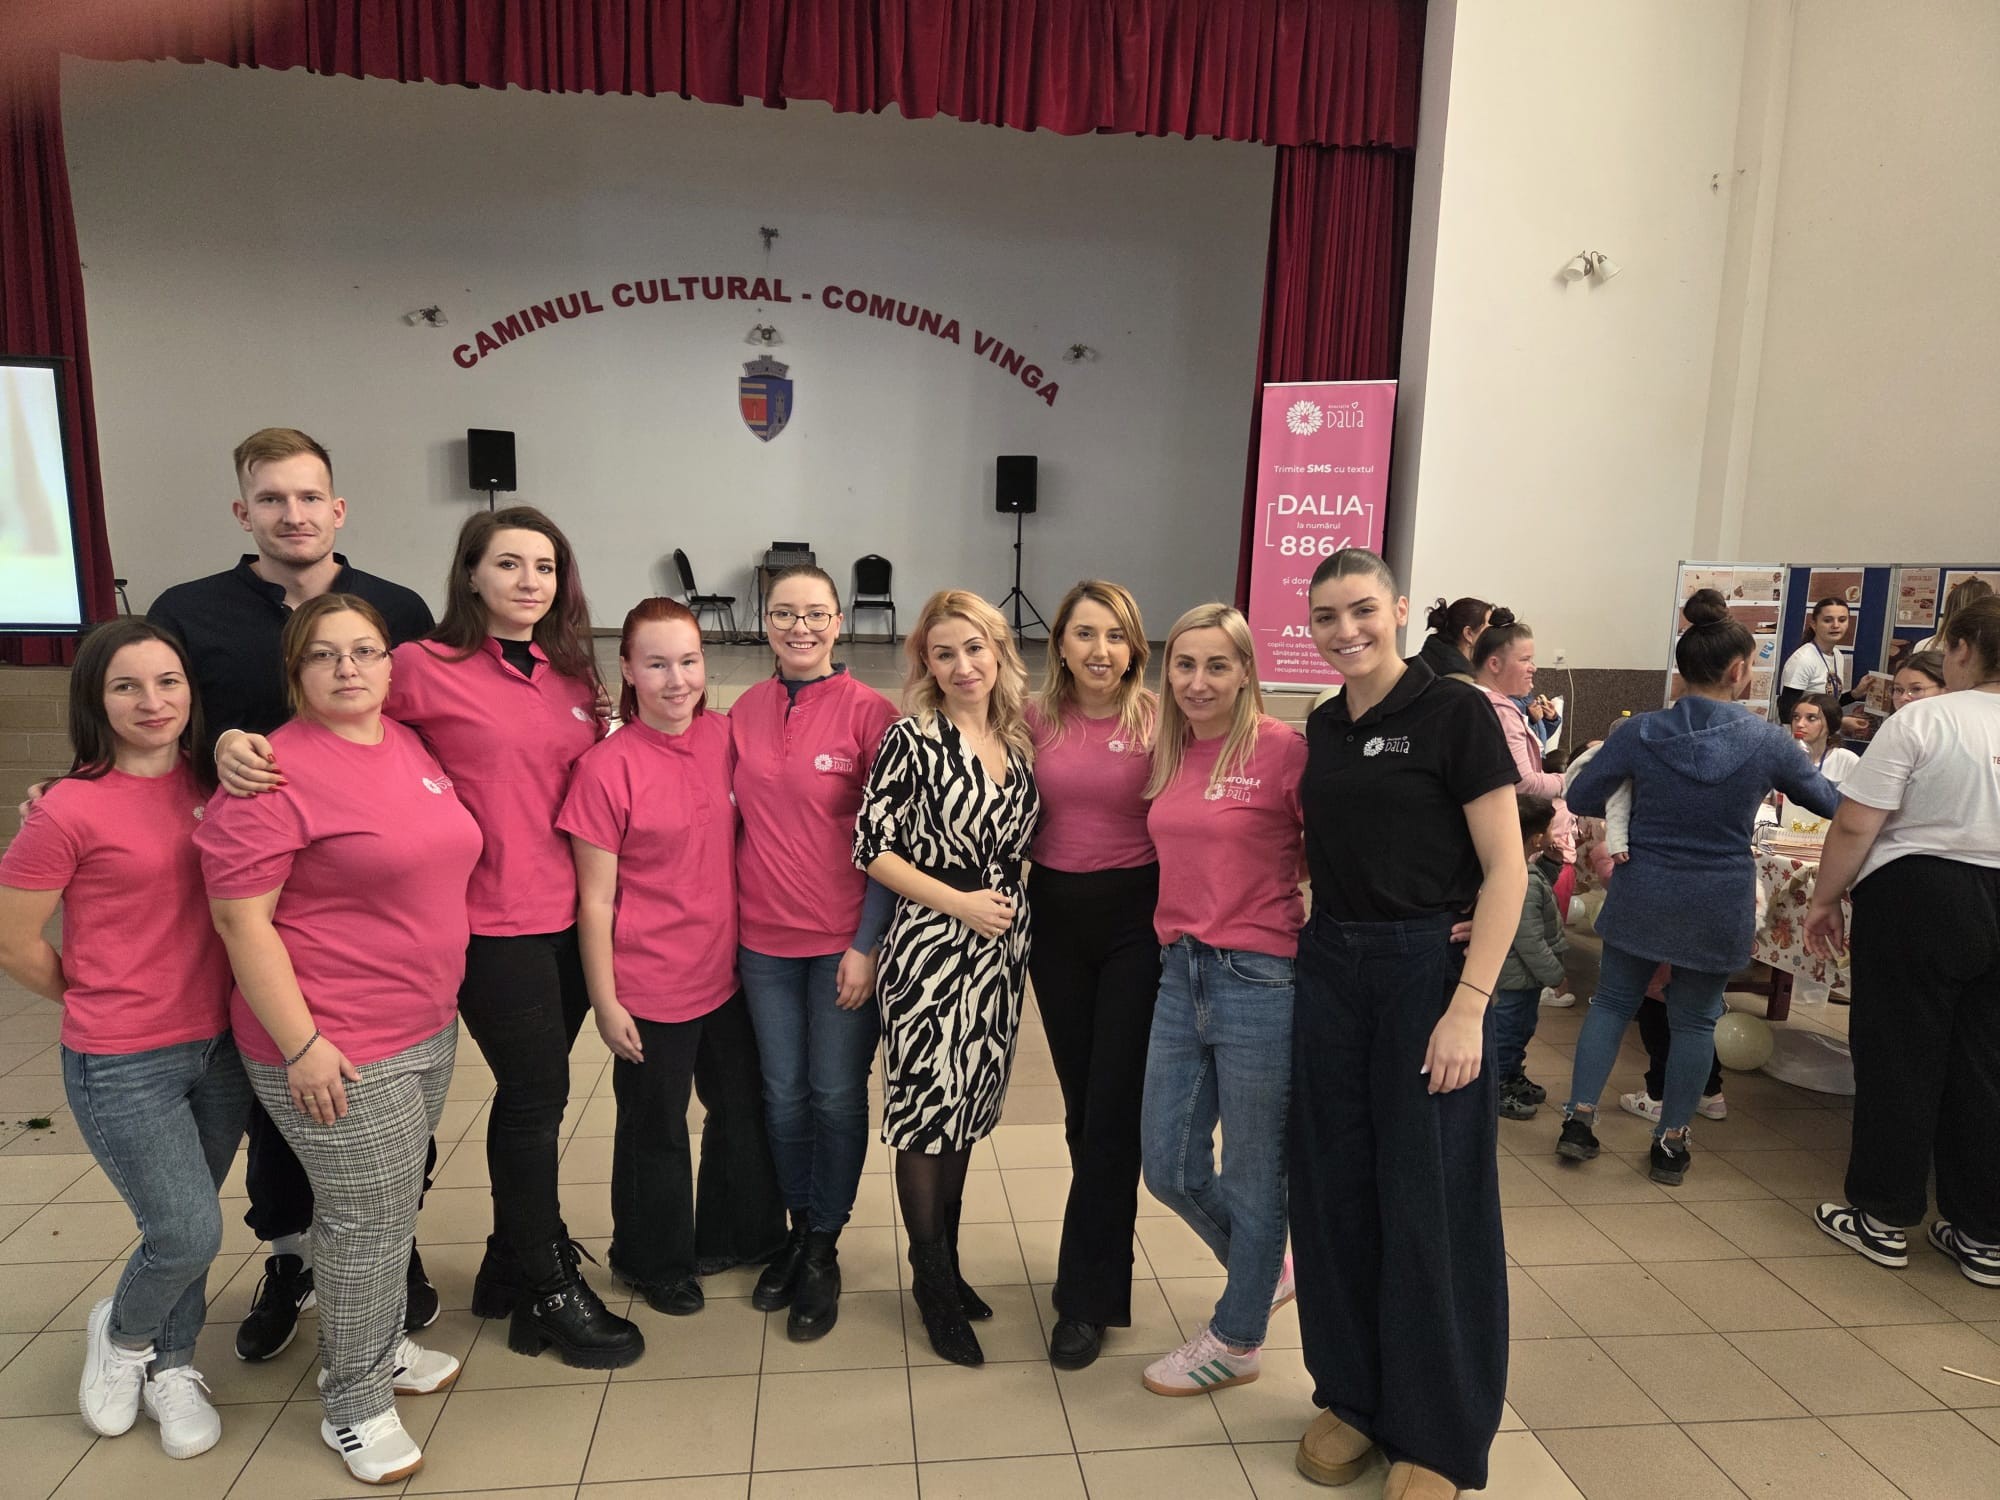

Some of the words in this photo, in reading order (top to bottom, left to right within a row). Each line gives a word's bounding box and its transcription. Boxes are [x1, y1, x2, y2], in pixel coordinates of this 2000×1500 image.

[453, 290, 604, 369] CAMINUL
[612, 276, 792, 307] CULTURAL
[822, 285, 961, 345] COMUNA
[973, 330, 1060, 407] VINGA
[1274, 465, 1305, 473] Trimite
[1306, 464, 1332, 473] SMS
[1277, 494, 1364, 516] DALIA
[1295, 588, 1303, 597] 4
